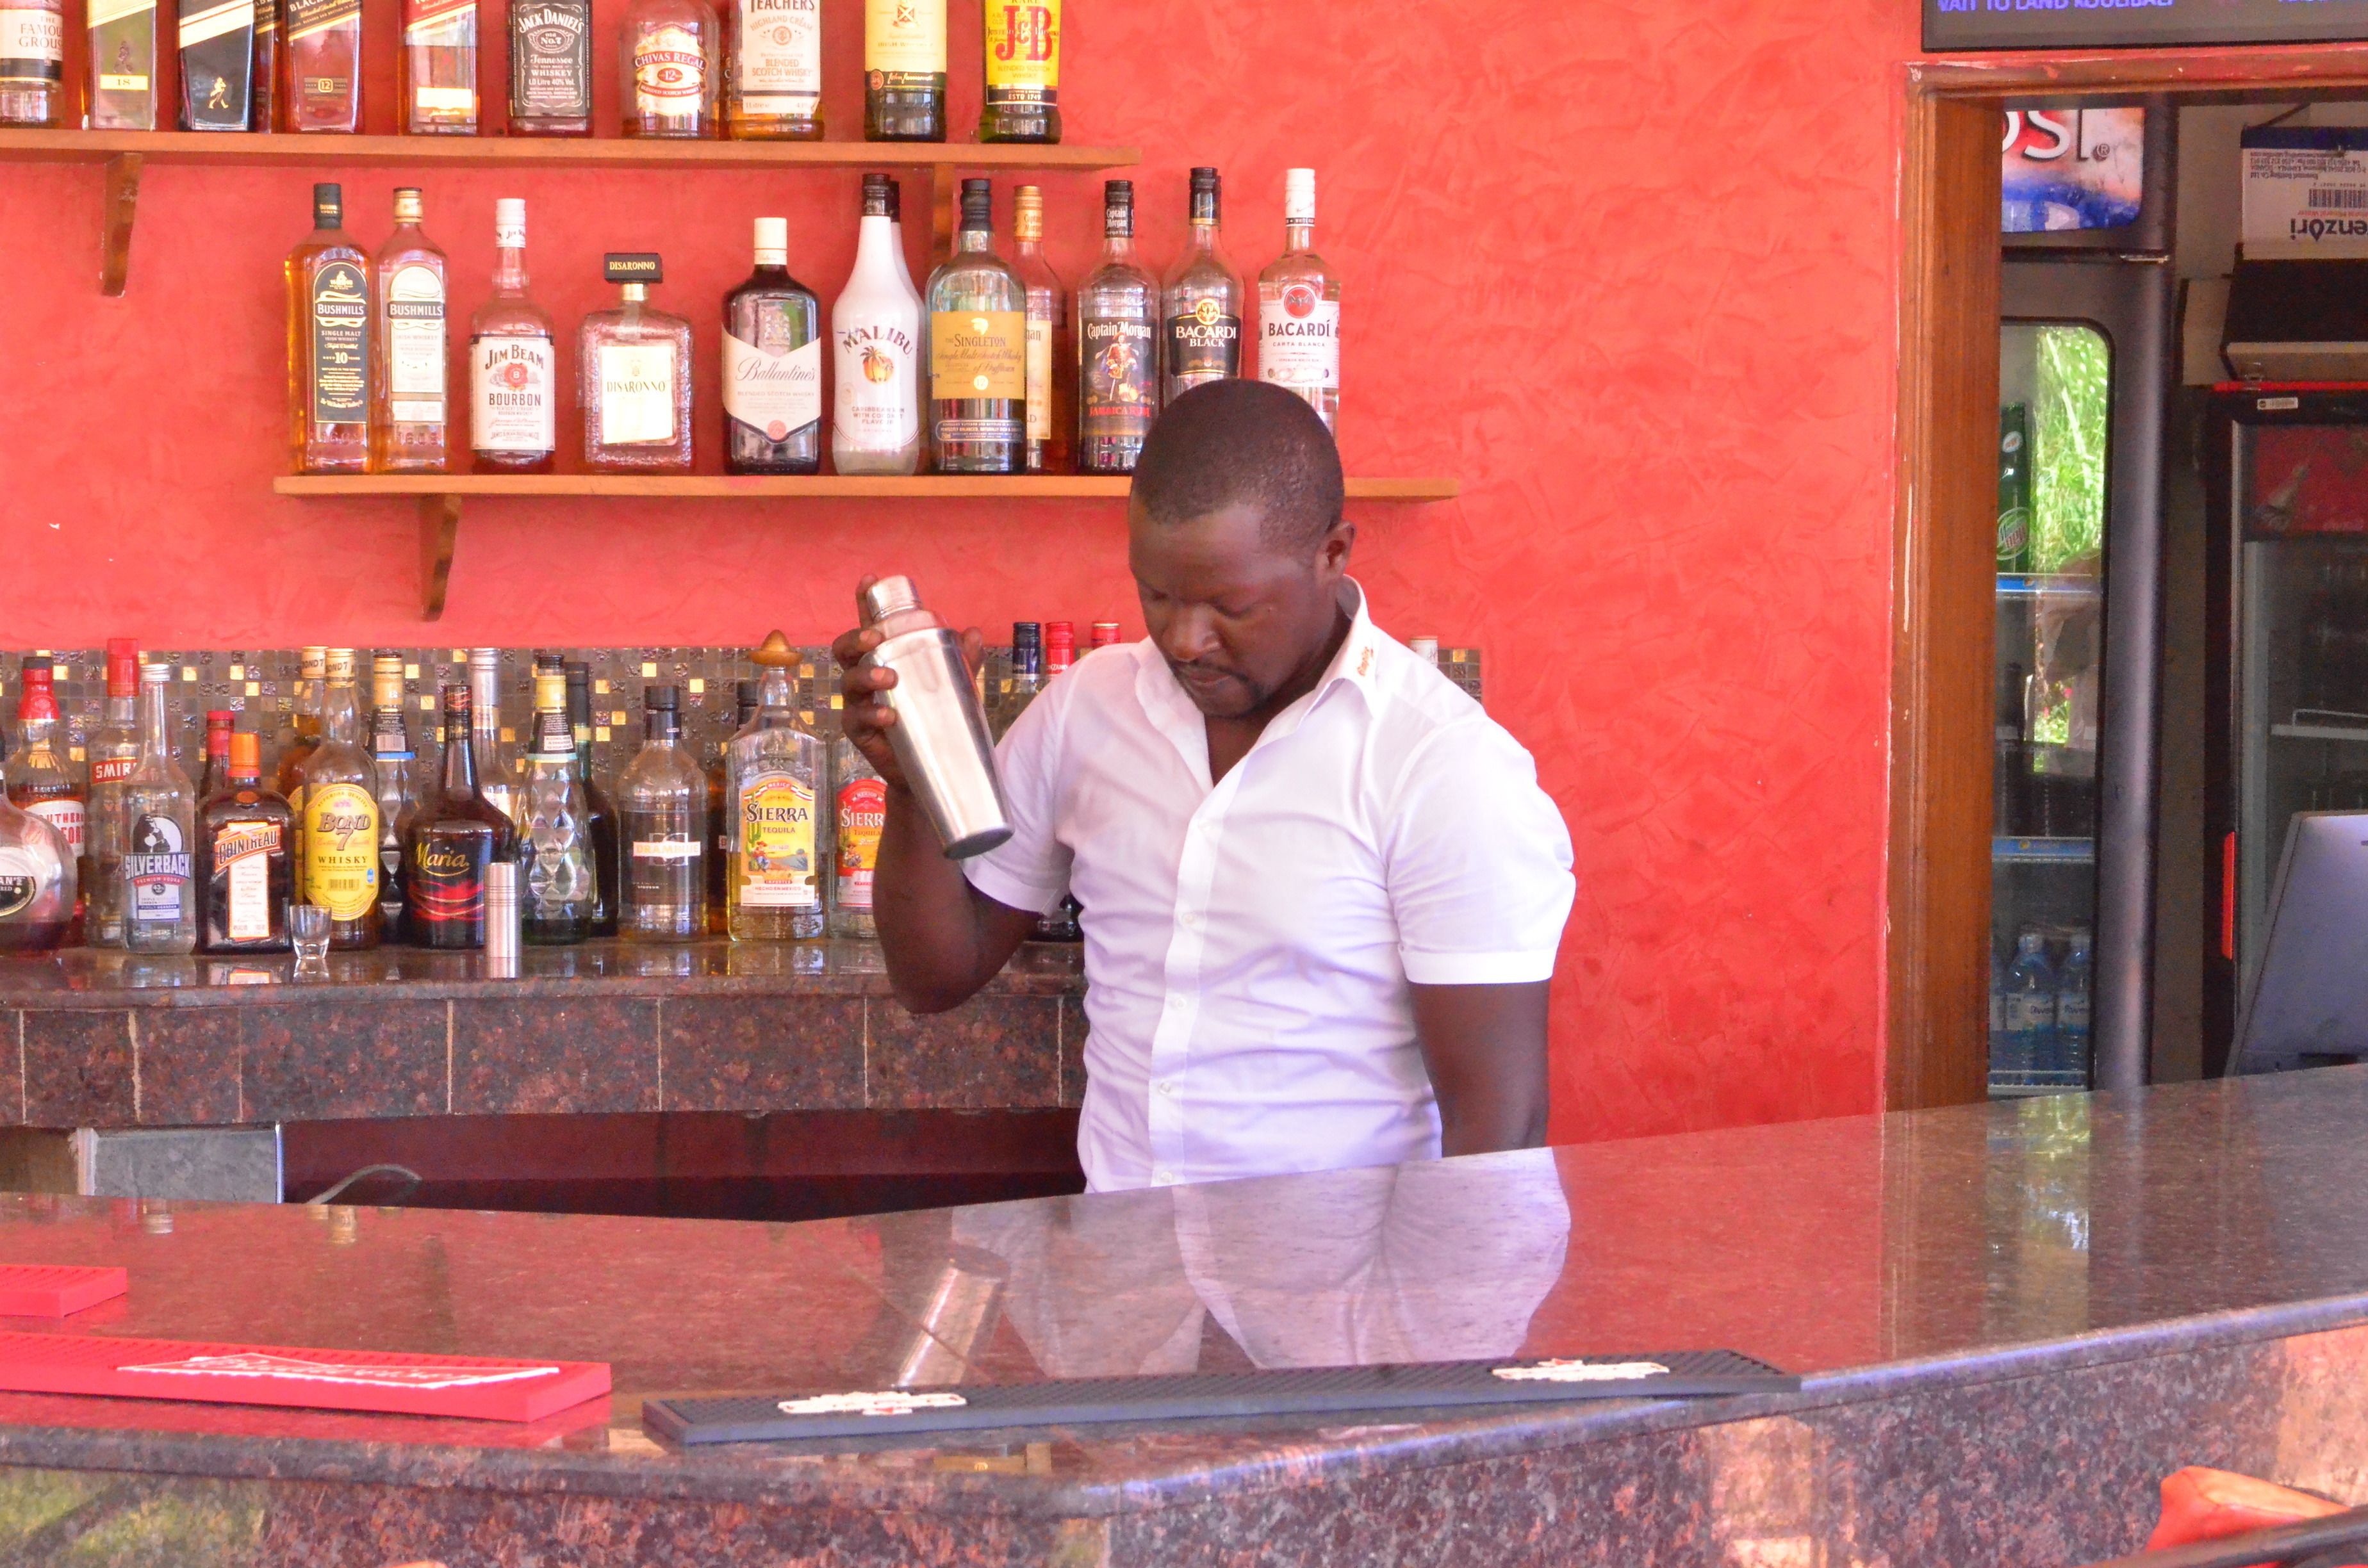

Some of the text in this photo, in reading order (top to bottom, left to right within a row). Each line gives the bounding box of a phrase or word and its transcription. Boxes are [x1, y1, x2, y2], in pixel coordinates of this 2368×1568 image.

[518, 8, 584, 35] JACK DANIEL'S
[750, 15, 788, 31] HIGHLAND
[21, 24, 62, 37] FAMOU
[530, 54, 573, 64] Tennessee
[634, 52, 705, 70] CHIVAS REGAL
[765, 58, 800, 67] BLENDED
[664, 70, 676, 81] 12
[752, 67, 812, 77] SCOTCH WHISKY
[116, 78, 131, 86] 18
[320, 81, 331, 90] 12
[1107, 208, 1126, 218] Captain
[1106, 218, 1127, 229] Morgan
[2290, 218, 2368, 241] enzori
[609, 261, 656, 271] DISARONNO
[317, 303, 365, 315] BUSHMILLS
[390, 304, 443, 316] BUSHMILLS
[1087, 321, 1151, 340] Captain Morgan
[1176, 325, 1237, 339] BACARDI
[1268, 319, 1331, 338] BACARDÍ
[843, 325, 913, 355] MALIBU
[953, 333, 1007, 348] SINGLETON
[1190, 338, 1225, 347] BLACK
[334, 352, 349, 364] 10
[485, 344, 544, 370] JIM BEAM
[736, 357, 816, 381] Ballantine's
[606, 381, 666, 393] DISARONNO
[488, 393, 541, 406] BOURBON
[1090, 406, 1150, 418] JAMAICA RUM
[318, 658, 324, 667] 7
[343, 660, 348, 671] 7
[96, 761, 136, 780] SMIR
[746, 801, 809, 823] SIERRA
[841, 806, 885, 828] SIERR
[317, 812, 372, 832] BOND
[336, 829, 354, 851] 7
[219, 831, 277, 865] COINTREAU
[636, 844, 699, 854] DRAMBUIE
[124, 853, 190, 880] SILVERBACK
[318, 856, 368, 864] WHISKY
